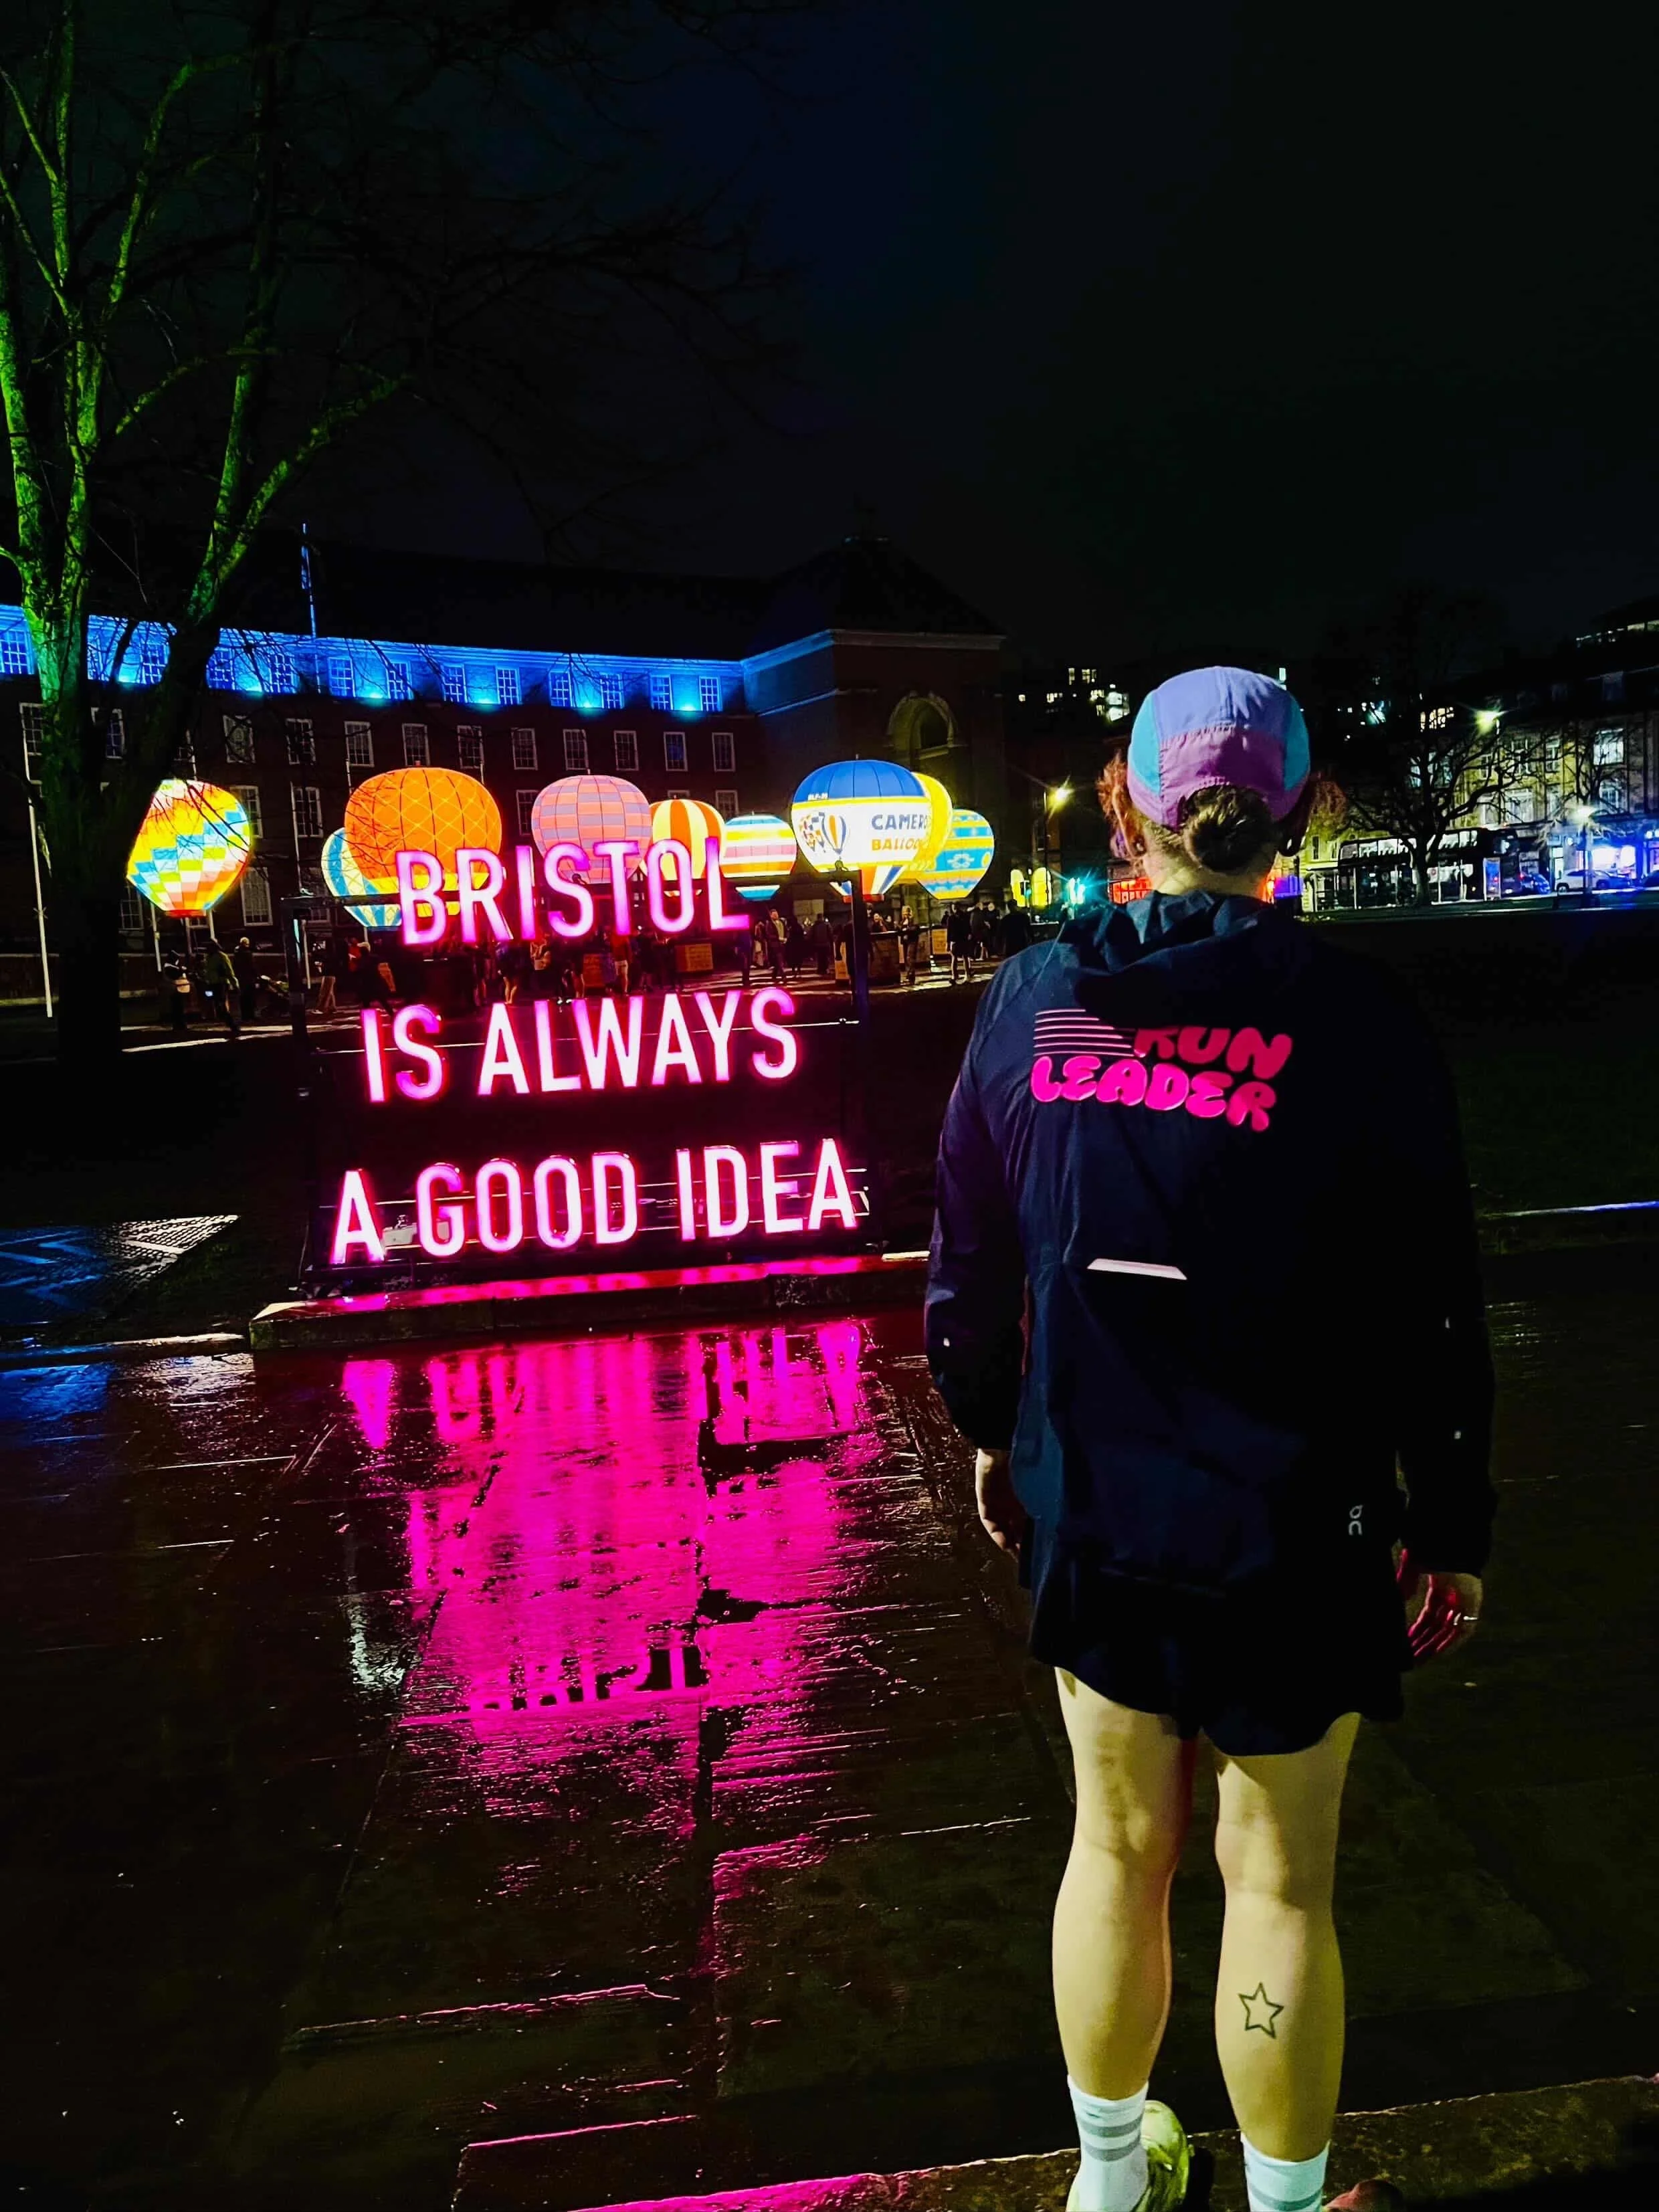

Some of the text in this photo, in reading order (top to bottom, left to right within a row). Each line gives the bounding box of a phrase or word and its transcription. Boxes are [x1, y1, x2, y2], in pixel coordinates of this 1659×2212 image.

[397, 837, 750, 945] BRISTOL
[362, 987, 799, 1102] IS ALWAYS
[1031, 1055, 1276, 1132] LEADER
[330, 1138, 858, 1265] A GOOD IDEA
